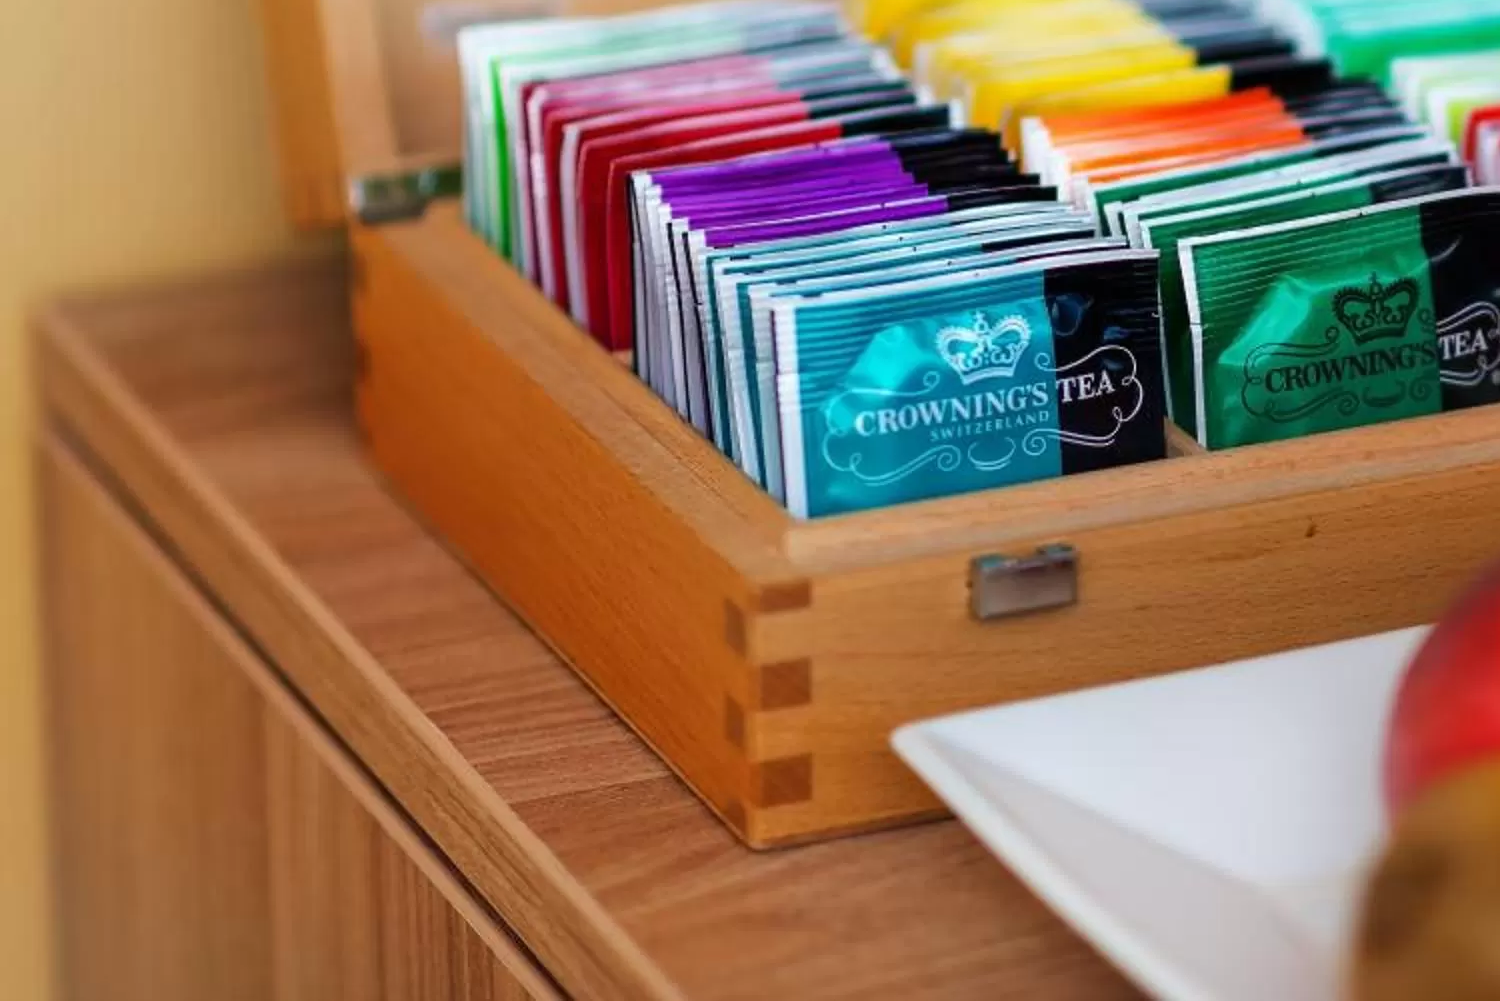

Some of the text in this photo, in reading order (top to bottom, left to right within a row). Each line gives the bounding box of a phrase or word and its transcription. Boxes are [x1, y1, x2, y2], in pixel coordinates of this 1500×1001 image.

[1264, 327, 1489, 393] CROWNING'S TEA
[855, 369, 1115, 437] CROWNING'S TEA
[930, 410, 1049, 442] SWITZERLAND
